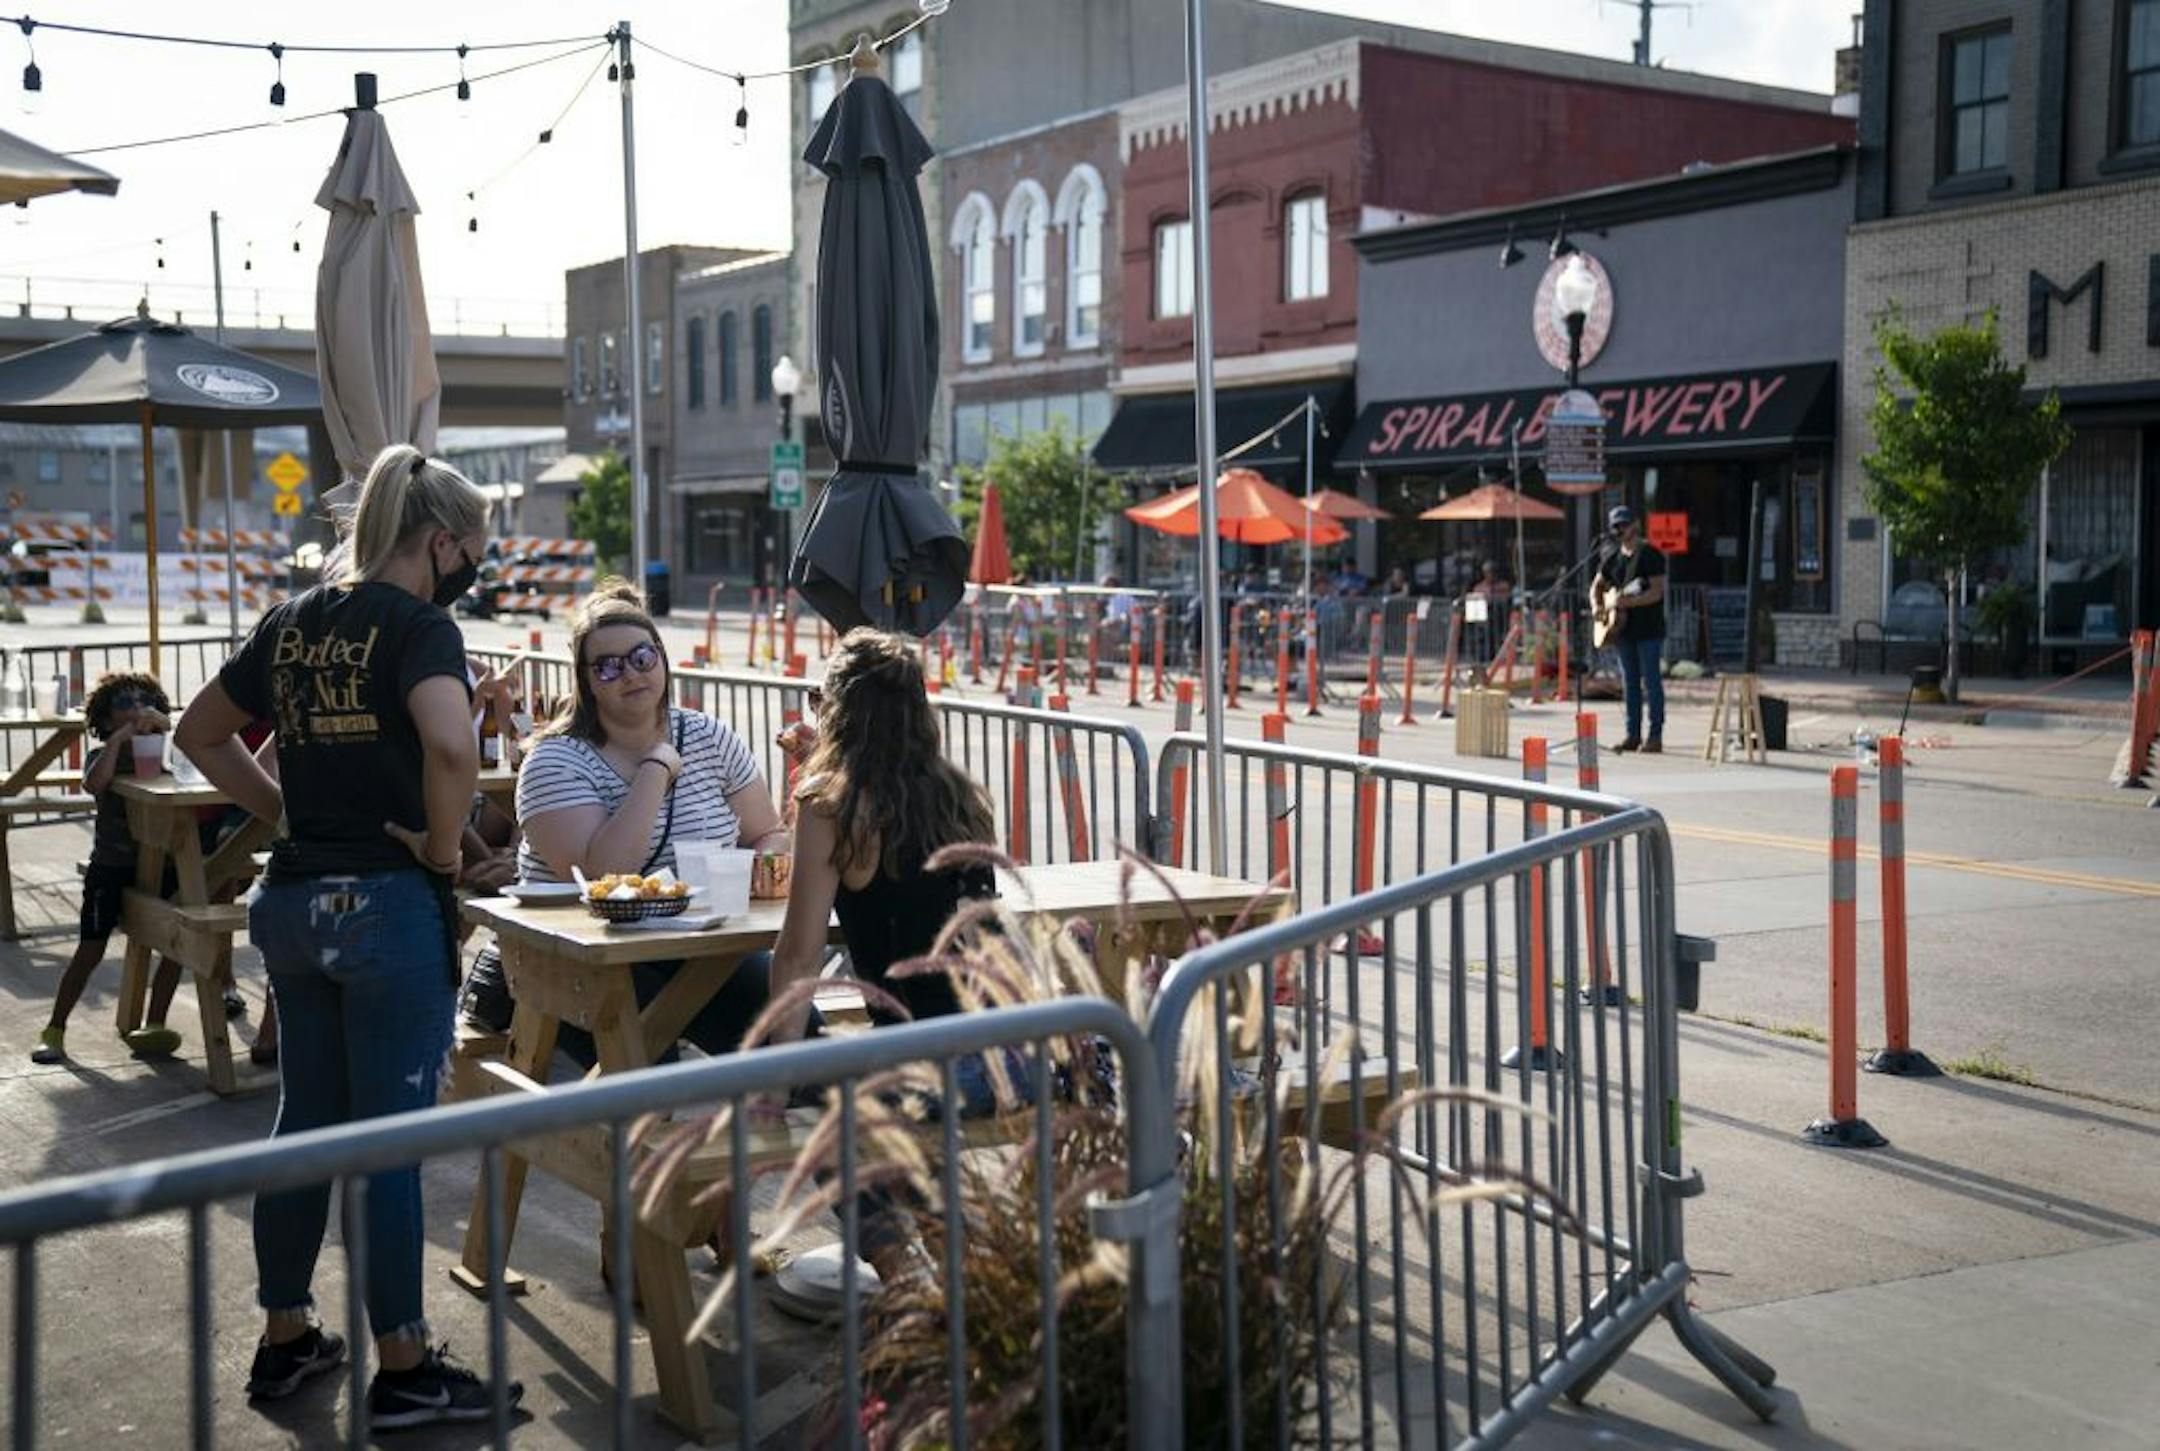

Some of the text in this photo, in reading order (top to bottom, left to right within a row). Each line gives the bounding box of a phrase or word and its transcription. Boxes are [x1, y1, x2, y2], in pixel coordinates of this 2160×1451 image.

[1369, 400, 1514, 453] SPIRAL
[1520, 375, 1786, 444] BEWERY
[308, 668, 368, 712] Nut
